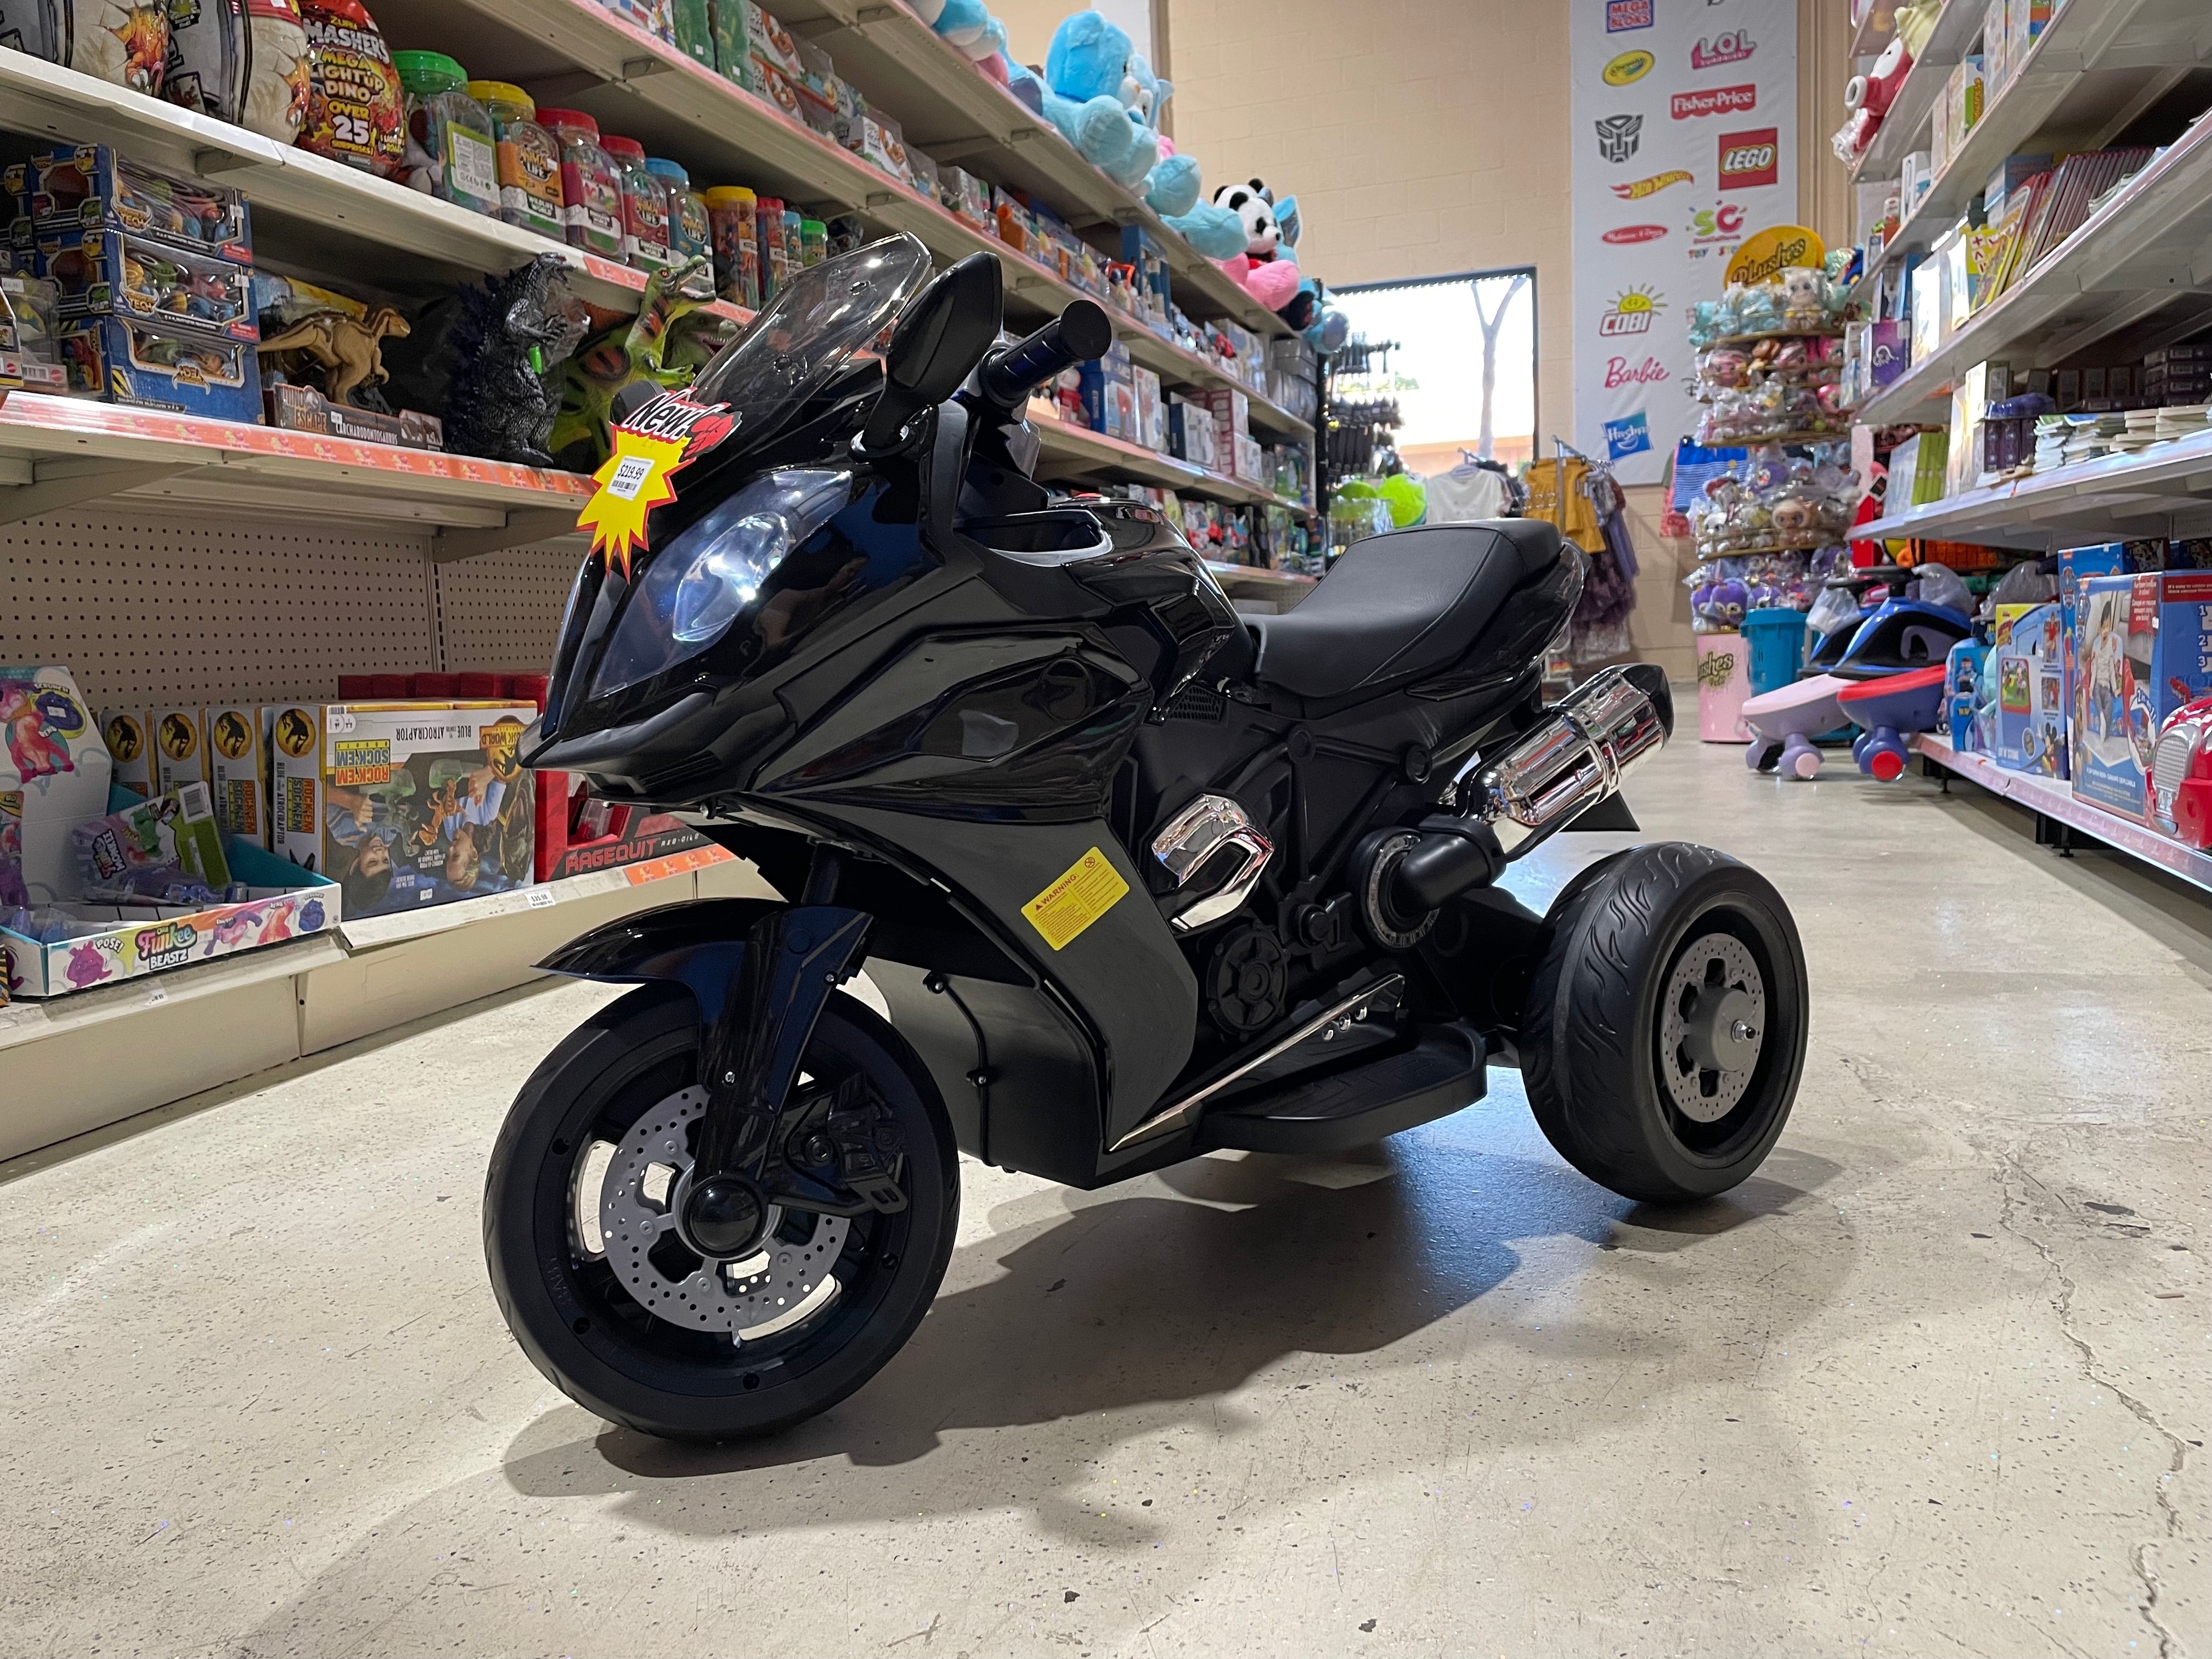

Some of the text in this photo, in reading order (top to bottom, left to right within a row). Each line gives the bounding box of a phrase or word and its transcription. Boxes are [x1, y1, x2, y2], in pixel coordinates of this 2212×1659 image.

[1699, 28, 1757, 58] LOL
[321, 49, 371, 70] MEGA
[324, 80, 371, 103] DINO
[329, 100, 370, 120] OVER
[332, 115, 369, 145] 25
[1724, 146, 1771, 172] LEGO
[120, 213, 144, 230] TECH
[1694, 204, 1743, 236] SC
[130, 298, 152, 313] TECH
[1602, 312, 1648, 334] COBI
[1604, 356, 1671, 388] Barbie
[295, 409, 328, 433] ESCAPE
[617, 462, 645, 480] $219.99
[2198, 604, 2207, 617] 1
[2198, 634, 2207, 646] 2
[2198, 656, 2207, 667] 3
[396, 726, 445, 741] ATROCIRAPTOR
[457, 725, 472, 738] BLUE
[481, 732, 507, 747] WORLD
[336, 748, 390, 766] SOCK'EM
[336, 769, 389, 785] ROCK'EM
[276, 762, 285, 844] BLUE ATROCIRAPTOR
[294, 779, 303, 831] SOCK'EM
[304, 780, 314, 832] ROCK'EM
[565, 838, 658, 876] RAGEQUIT
[95, 936, 125, 954] POSE!
[137, 923, 196, 958] Funkee
[149, 949, 188, 970] BEASTZ
